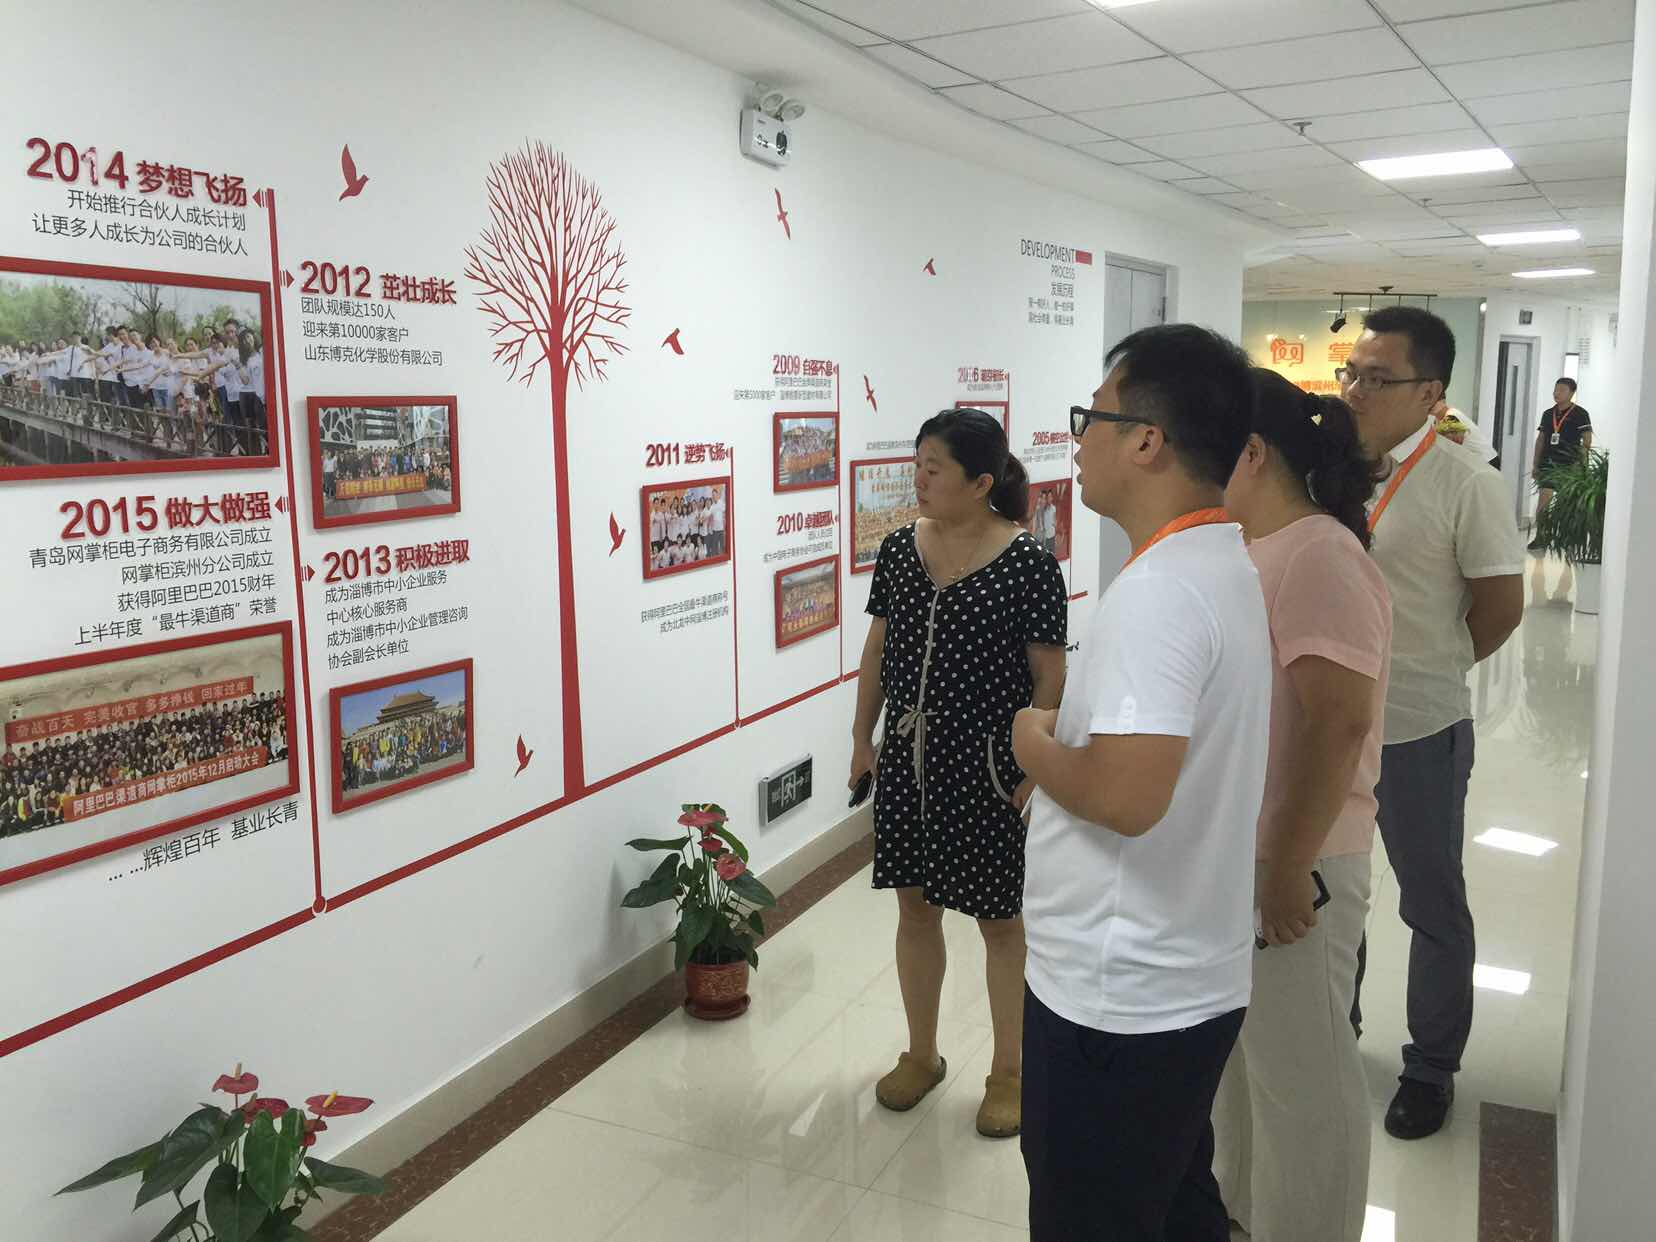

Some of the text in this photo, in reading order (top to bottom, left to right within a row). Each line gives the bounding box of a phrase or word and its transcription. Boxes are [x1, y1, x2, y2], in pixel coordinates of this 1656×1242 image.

[26, 137, 248, 207] 2014 梦想飞扬
[67, 189, 246, 231] 开始推行合伙人成长计划
[32, 213, 249, 256] 让更多人成长为公司的合伙人
[1020, 238, 1074, 264] DEVELOPMENT
[300, 260, 457, 305] 2012 茁壮成长
[301, 297, 396, 320] 团队规模达150人
[302, 320, 409, 343] 迎来第10000家客户
[304, 343, 443, 367] 山东博克化学股份有限公司
[772, 354, 800, 375] 2009
[646, 442, 726, 467] 2011 逆势飞扬
[59, 491, 272, 541] 2015 做大做强
[776, 511, 803, 536] 2010
[29, 526, 273, 569] 青岛网掌柜电子商务有限公司成立
[323, 539, 471, 584] 2013 积极进取
[121, 549, 274, 585] 网掌柜滨州分公司成立
[117, 573, 275, 613] 获得阿里巴巴2015财年
[325, 569, 448, 604] 成为淄博市中小企业服务
[326, 597, 408, 627] 中心核心服务商
[326, 606, 469, 649] 成为淄博市中小企业管理咨询
[327, 639, 410, 671] 协会副会长单位
[231, 801, 299, 840] 基业长青
